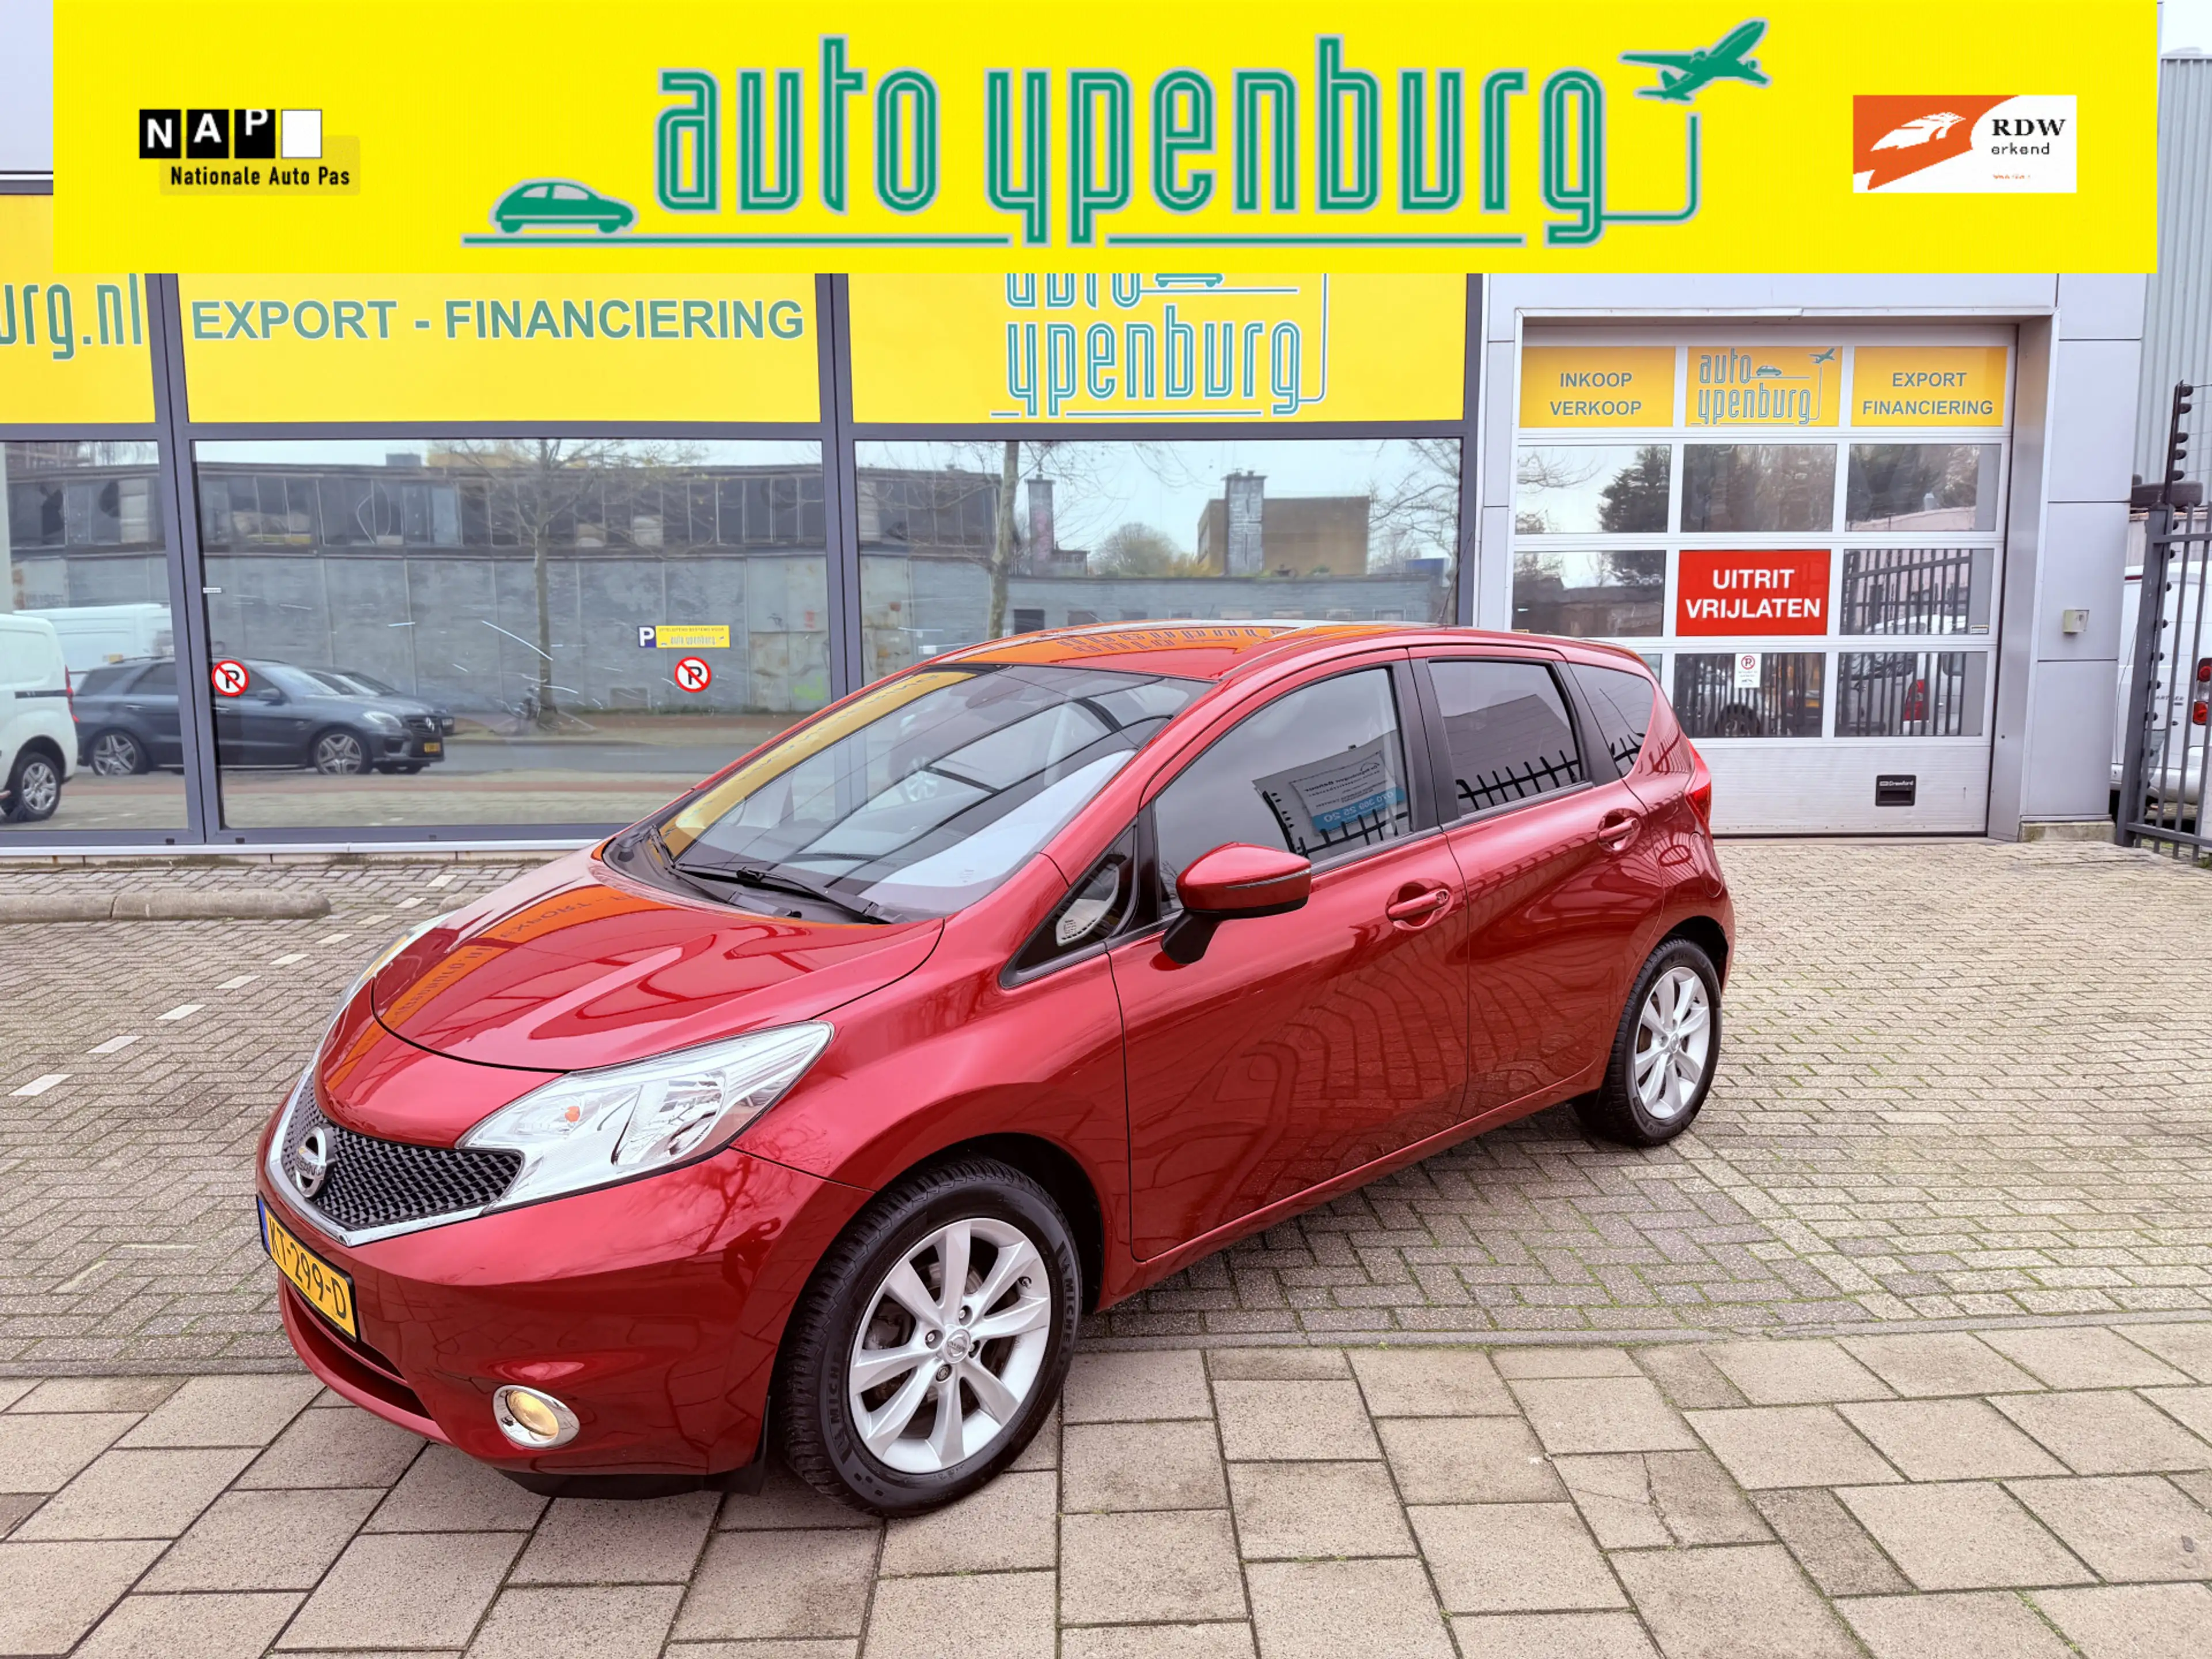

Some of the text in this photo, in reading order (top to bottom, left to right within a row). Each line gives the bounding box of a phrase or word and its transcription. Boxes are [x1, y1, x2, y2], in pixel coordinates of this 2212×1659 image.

[191, 300, 397, 339] EXPORT
[445, 299, 804, 339] FINANCIERING
[1006, 303, 1302, 416] ypenburg
[1699, 347, 1751, 384] auto
[1560, 372, 1633, 388] INKOOP
[1892, 372, 1967, 388] EXPORT
[1550, 400, 1642, 416] VERKOOP
[1698, 382, 1811, 425] ypenburg
[1862, 400, 1994, 415] FINANCIERING
[1713, 569, 1795, 589] UITRIT
[1685, 598, 1821, 619] VRIJLATEN
